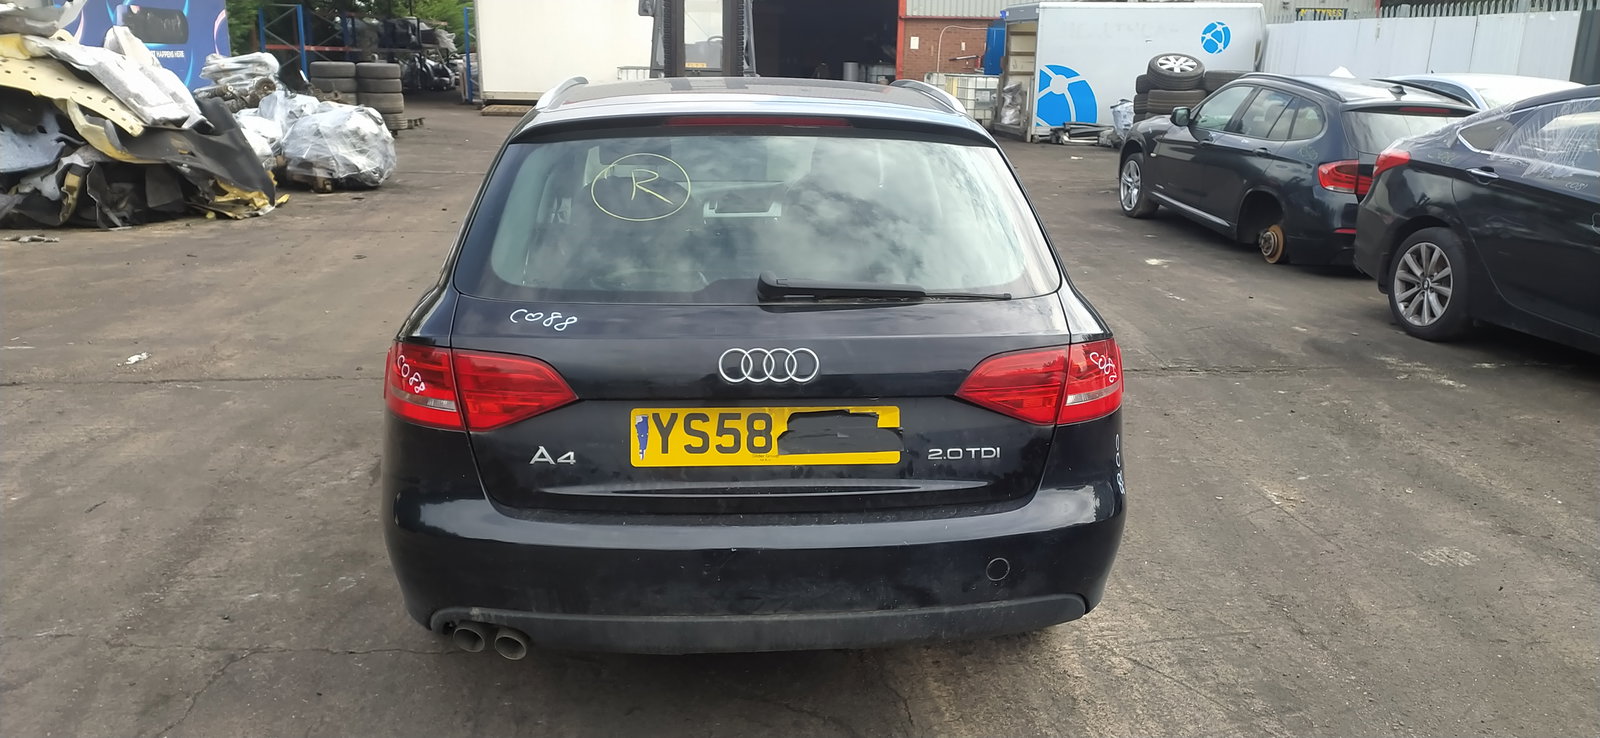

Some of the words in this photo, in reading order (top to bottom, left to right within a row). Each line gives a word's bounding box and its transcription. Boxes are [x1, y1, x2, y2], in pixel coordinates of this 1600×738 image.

[631, 169, 674, 205] R
[651, 412, 773, 454] YS58
[529, 445, 576, 465] A4
